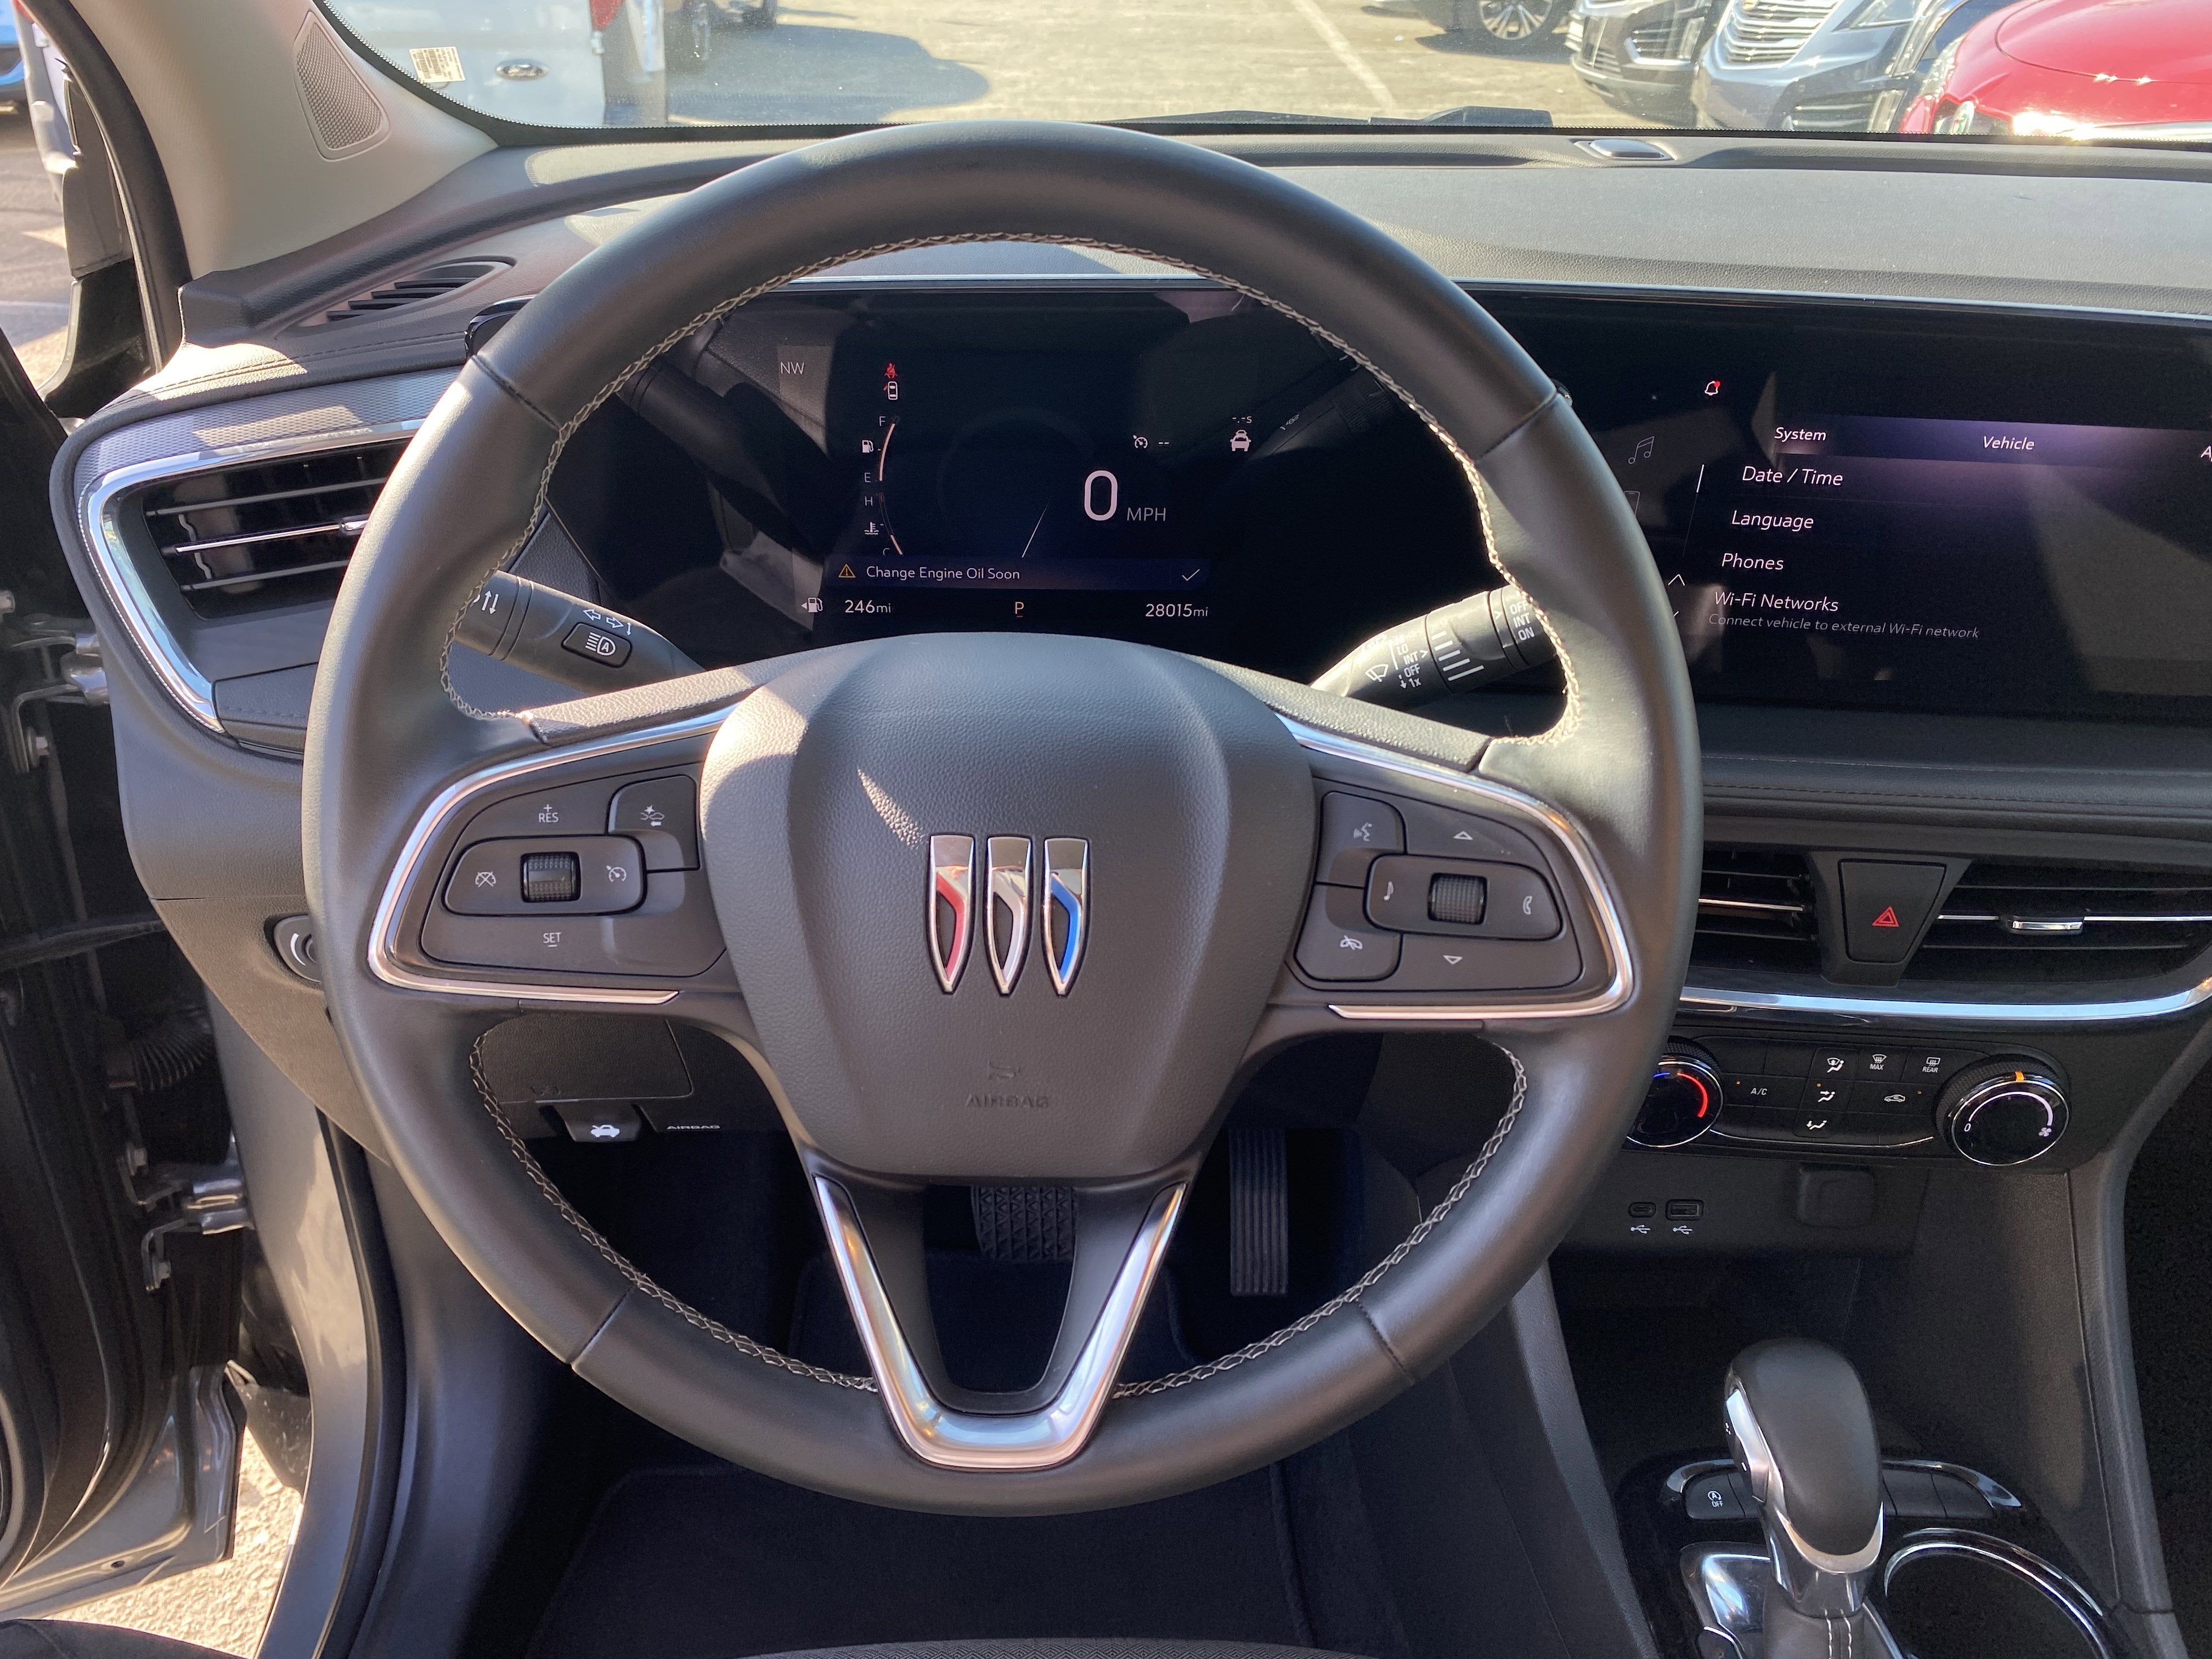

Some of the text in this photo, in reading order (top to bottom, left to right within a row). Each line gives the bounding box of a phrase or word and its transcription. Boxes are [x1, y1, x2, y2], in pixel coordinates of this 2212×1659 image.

[780, 362, 804, 375] NW
[879, 416, 886, 426] F
[1774, 427, 1826, 442] System
[1983, 436, 2035, 450] Vehicle
[865, 473, 871, 482] E
[1742, 466, 1782, 483] Date
[1802, 469, 1843, 486] Time
[865, 496, 872, 506] H
[1084, 470, 1118, 521] 0
[1127, 507, 1166, 521] MPH
[1731, 511, 1814, 532] Language
[1722, 553, 1784, 570] Phones
[867, 566, 1020, 581] Change Engine Oil Soon
[1015, 602, 1024, 614] P
[1509, 600, 1530, 615] OFF
[1715, 591, 1838, 612] Wi-Fi Networks
[1513, 612, 1531, 628] INT
[1709, 613, 1978, 638] Connect vehicle to external Wi-Fi network
[1517, 627, 1536, 641] ON
[1396, 643, 1409, 656] LO
[1403, 650, 1419, 665] INT
[1403, 663, 1421, 678] OFF
[538, 812, 559, 823] RES
[543, 932, 562, 944] SET
[1751, 1087, 1767, 1096] A/C
